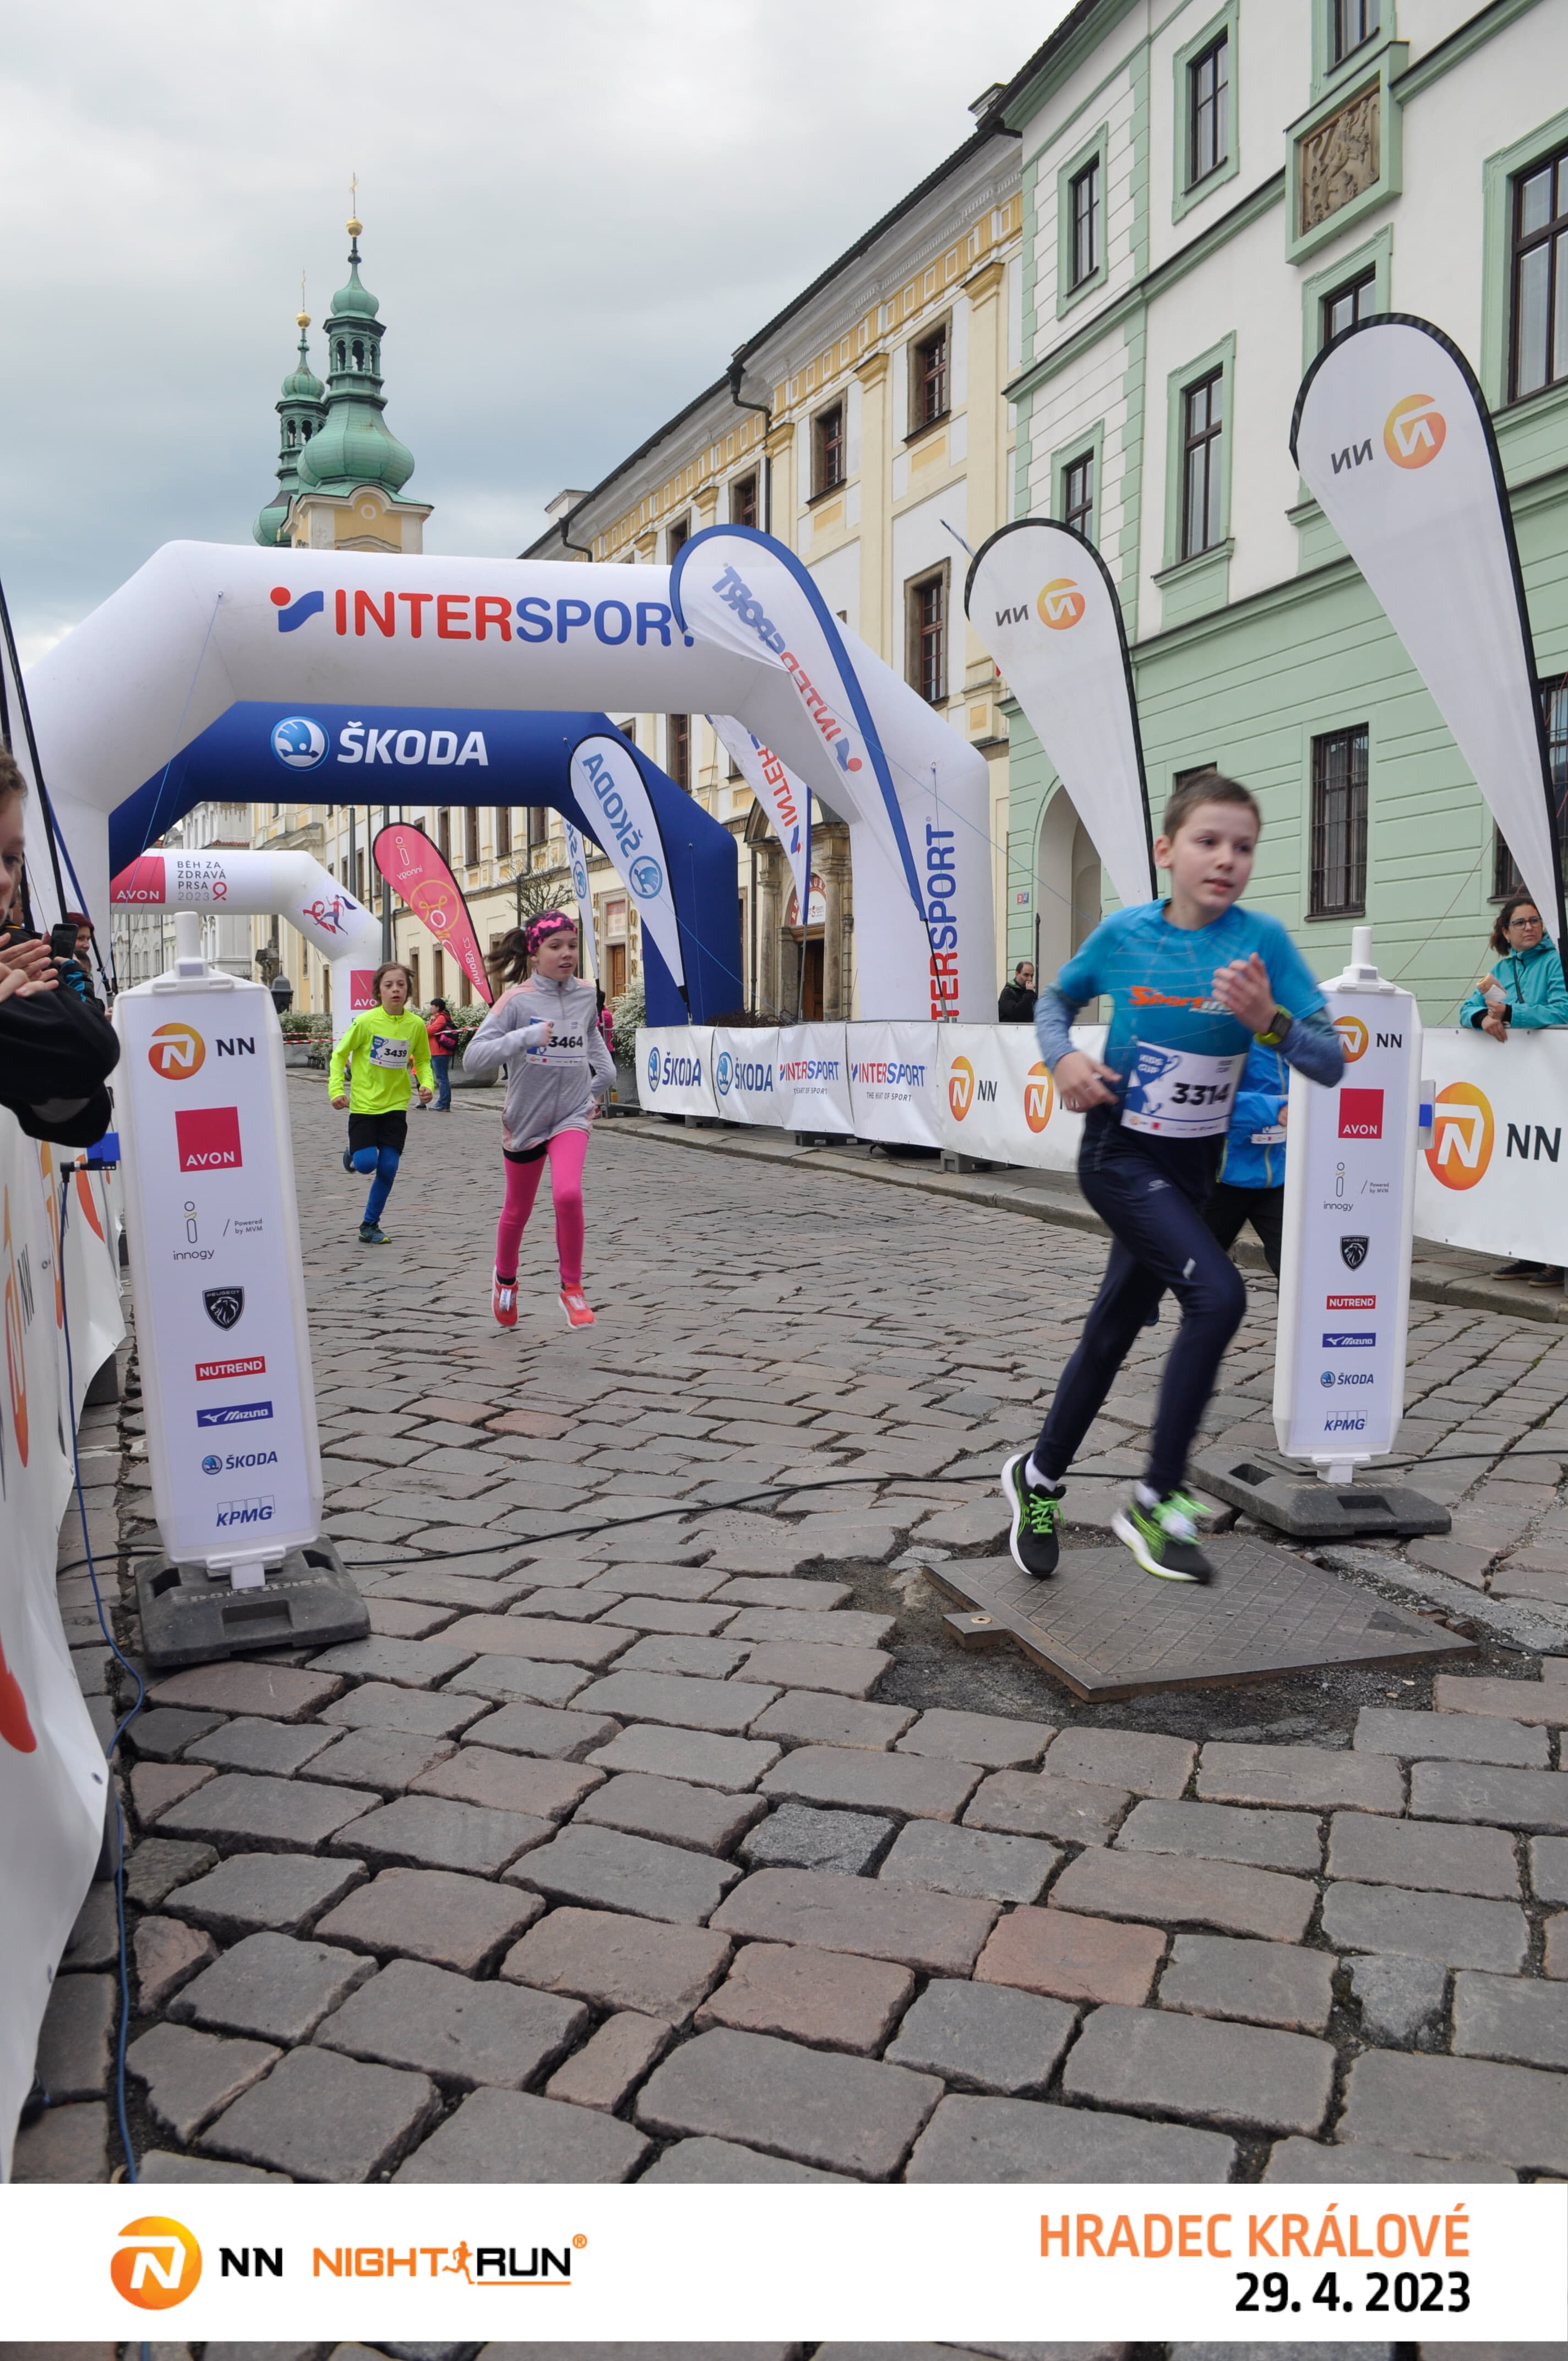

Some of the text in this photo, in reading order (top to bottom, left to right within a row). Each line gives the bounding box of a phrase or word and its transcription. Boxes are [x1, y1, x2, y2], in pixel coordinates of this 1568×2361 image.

[335, 588, 694, 647] INTERSPOR
[337, 721, 489, 767] ŠKODA
[177, 860, 200, 868] BĚH
[177, 869, 227, 879] ZDRAVÁ
[178, 881, 209, 890] PRSA
[116, 890, 160, 900] AVON
[178, 891, 210, 901] 2023
[925, 823, 960, 1020] TERSPORT
[354, 998, 378, 1007] AVO
[215, 1036, 256, 1057] NN
[548, 1035, 584, 1048] 3464
[1376, 1033, 1403, 1049] NN
[384, 1048, 407, 1058] 3439
[662, 1051, 701, 1087] ŠKODA
[786, 1060, 840, 1081] INTERSPORT
[859, 1062, 925, 1087] INTERSPORT
[891, 1092, 912, 1102] SPORT
[978, 1079, 998, 1102] NN
[1170, 1082, 1233, 1106] 3314
[1342, 1124, 1378, 1135] AVON
[1506, 1122, 1562, 1163] NN
[186, 1150, 235, 1166] AVON
[1323, 1201, 1354, 1211] innogy
[235, 1227, 243, 1235] by
[173, 1249, 215, 1261] innogy
[206, 1290, 240, 1298] PEUGEOT
[1329, 1297, 1374, 1308] NUTREND
[199, 1359, 263, 1377] NUTREND
[1337, 1373, 1374, 1385] ŠKODA
[1324, 1418, 1366, 1432] KPMG
[225, 1450, 278, 1470] ŠKODA
[216, 1505, 274, 1527] KPMG
